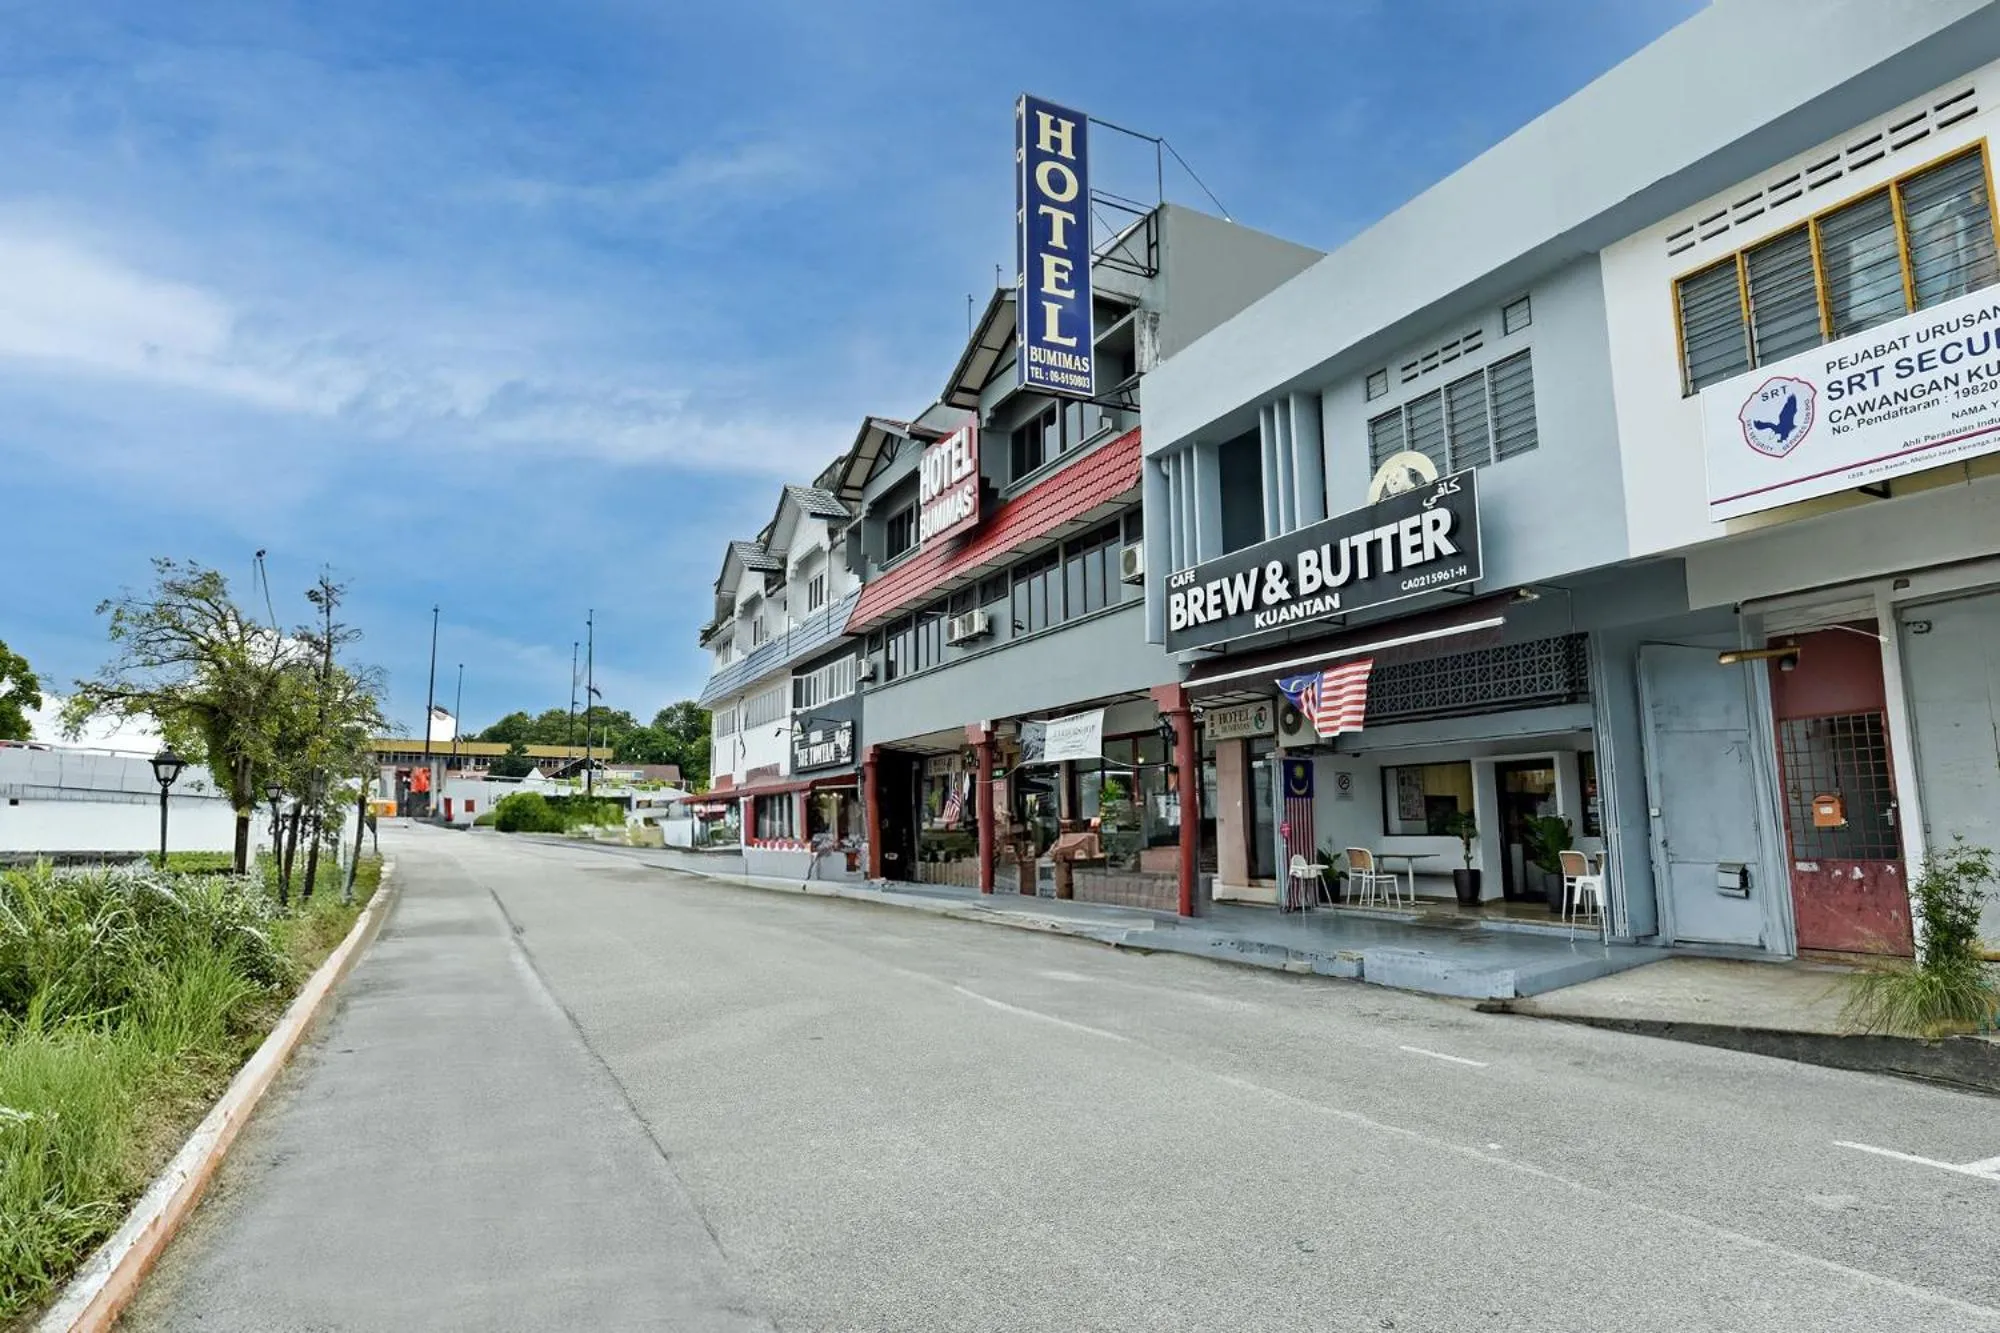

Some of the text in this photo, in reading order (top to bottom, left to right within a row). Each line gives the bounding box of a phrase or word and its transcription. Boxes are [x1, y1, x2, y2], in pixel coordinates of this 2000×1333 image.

[1035, 110, 1079, 347] HOTEL
[1030, 345, 1090, 373] BUMIMAS
[1826, 335, 1910, 374] PEJABAT
[1827, 327, 2000, 401] SRT SECU
[1030, 366, 1044, 380] TEL
[1761, 385, 1787, 402] SRT
[1829, 373, 1960, 424] CAWANGAN
[1967, 360, 2000, 383] KU
[1832, 425, 1854, 436] No.
[1857, 397, 1940, 429] Pendaftaran
[1951, 403, 1987, 420] NAMA
[920, 427, 974, 506] HOTEL
[1422, 477, 1461, 509] كافي
[1170, 508, 1459, 632] BREW & BUTTER
[1171, 570, 1196, 589] CAFE
[1400, 565, 1467, 591] CA0215961-H
[1255, 593, 1340, 629] KUANTAN
